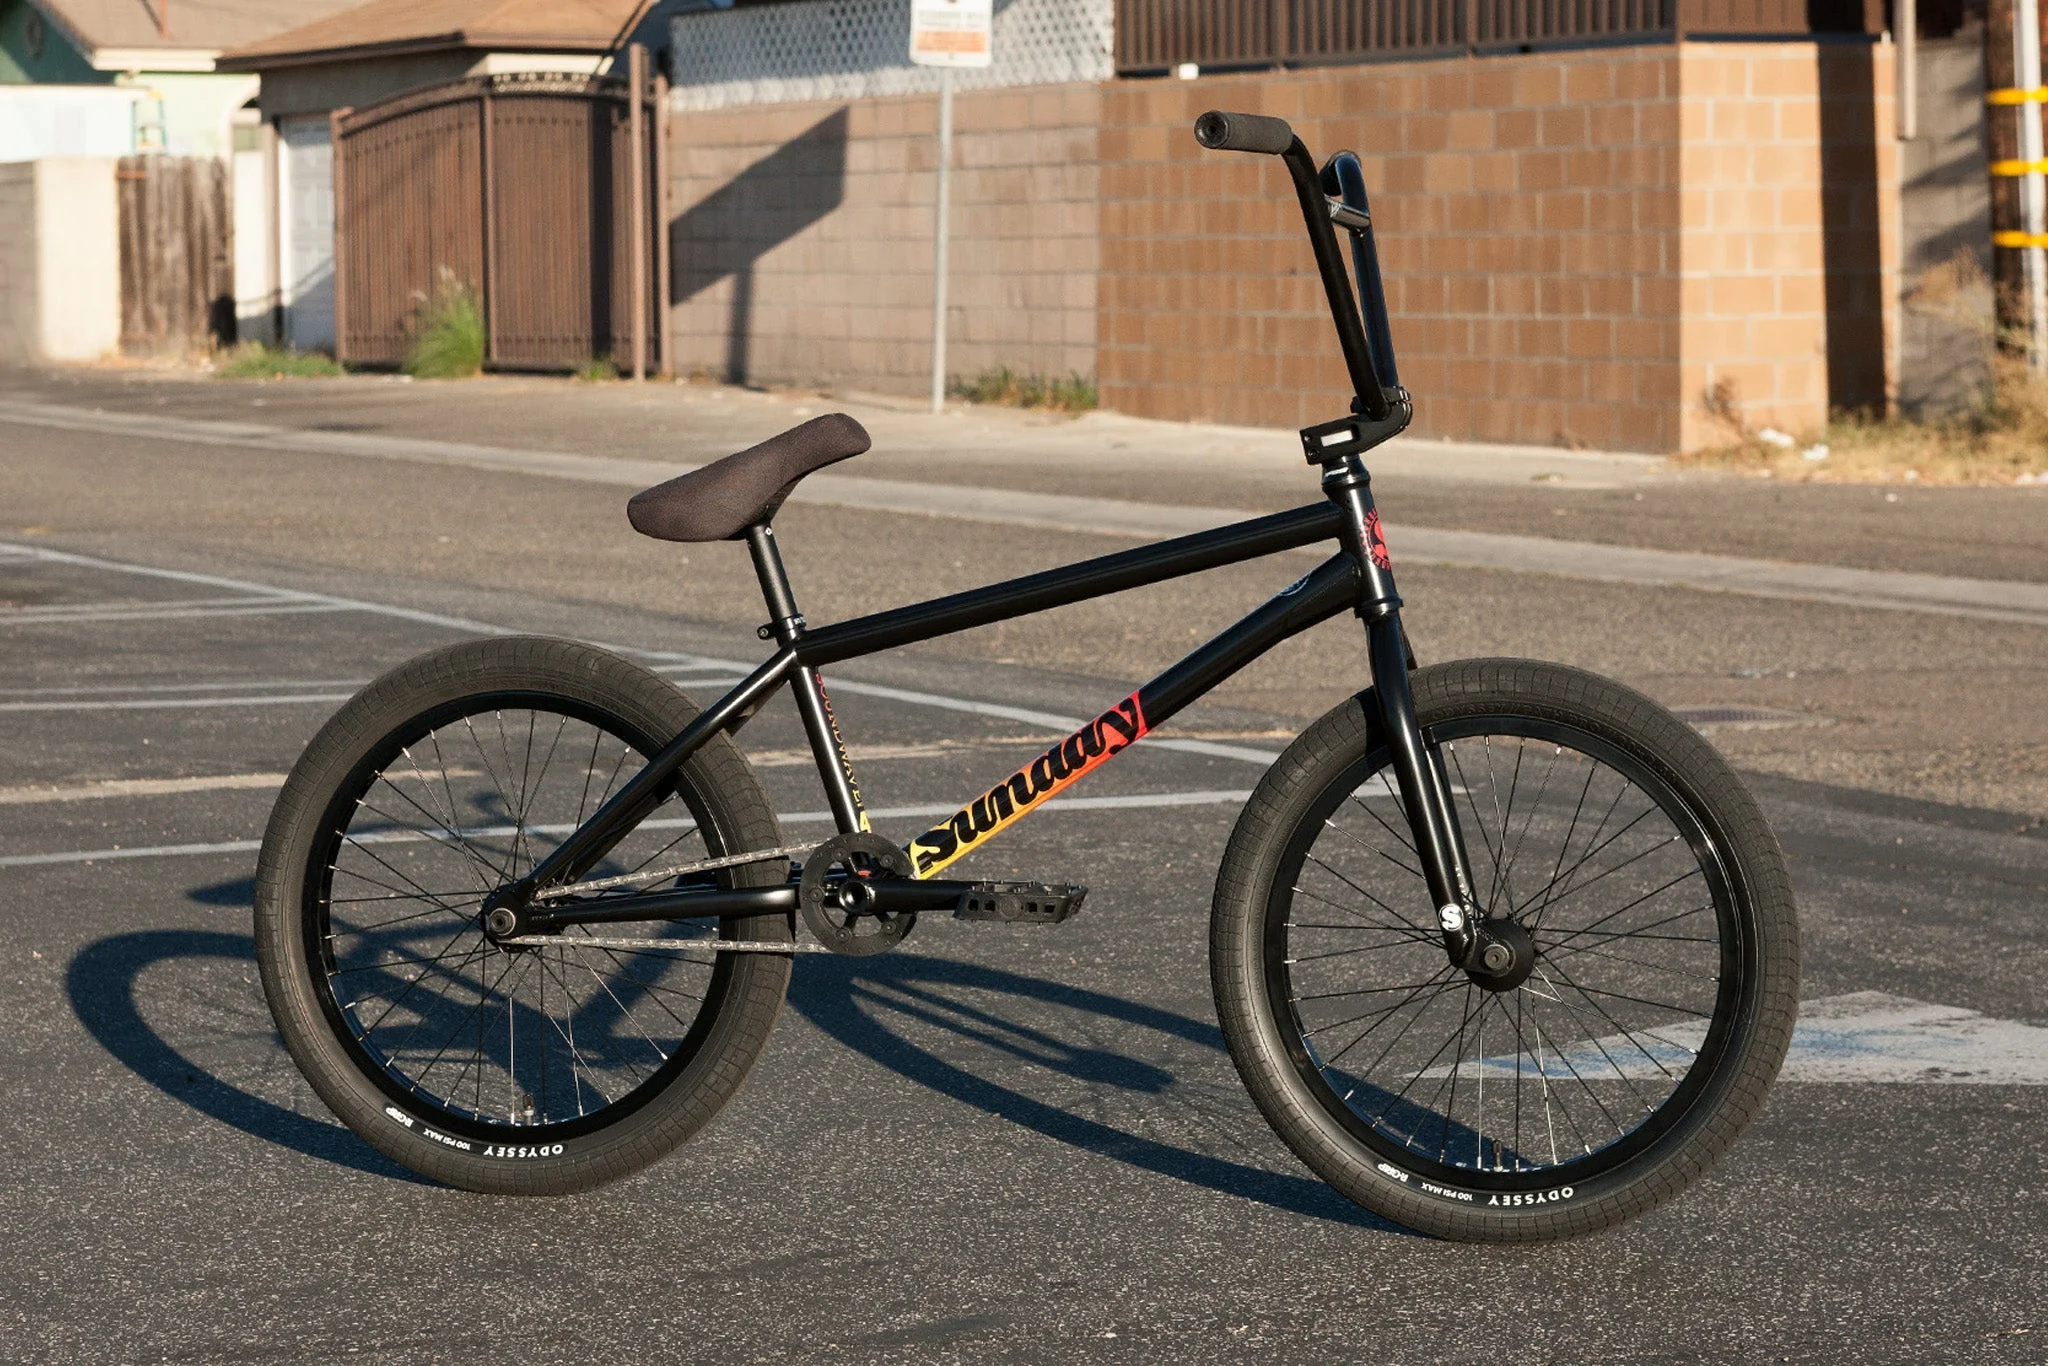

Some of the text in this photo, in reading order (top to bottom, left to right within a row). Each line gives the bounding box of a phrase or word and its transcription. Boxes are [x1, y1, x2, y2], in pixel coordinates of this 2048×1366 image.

[423, 1128, 443, 1142] MAX
[442, 1136, 457, 1147] PSI
[455, 1140, 471, 1151] 100
[483, 1144, 564, 1158] ODYSSEY
[1420, 1182, 1443, 1195] MAX
[1442, 1188, 1457, 1198] PSI
[1457, 1192, 1473, 1201] 100
[1487, 1186, 1574, 1206] ODYSSEY
